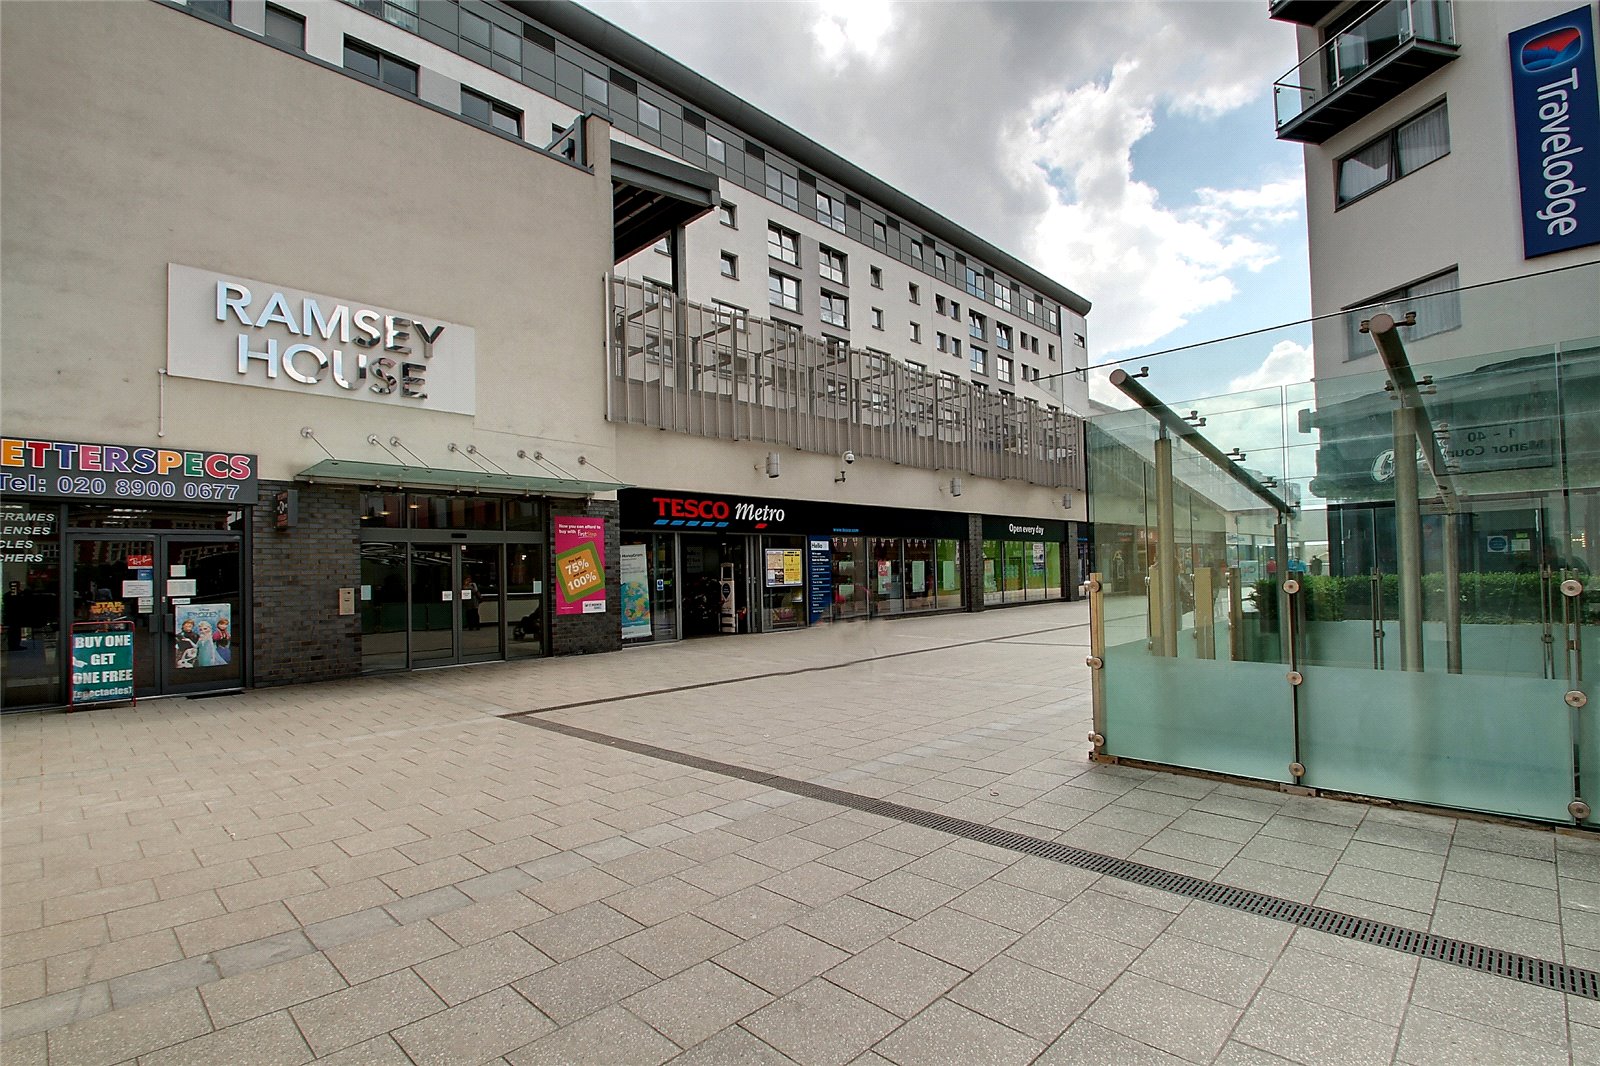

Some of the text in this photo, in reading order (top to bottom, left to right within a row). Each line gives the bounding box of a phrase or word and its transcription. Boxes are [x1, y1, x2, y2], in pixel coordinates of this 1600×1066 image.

[1536, 67, 1587, 236] Travelodge
[215, 279, 446, 359] RAMSEY
[237, 333, 429, 400] HOUSE
[0, 438, 251, 480] ETTERSPECS
[0, 472, 240, 500] Tel: 020 8900 0677
[0, 512, 55, 521] FRAMES
[653, 497, 785, 522] TESCO Metro
[0, 526, 51, 535] ENSES
[1008, 523, 1044, 535] Open every day
[565, 559, 589, 575] 75%
[568, 572, 597, 590] 100%
[75, 635, 131, 648] BUY ONE
[90, 653, 116, 665] GET
[73, 669, 133, 684] ONE FREE
